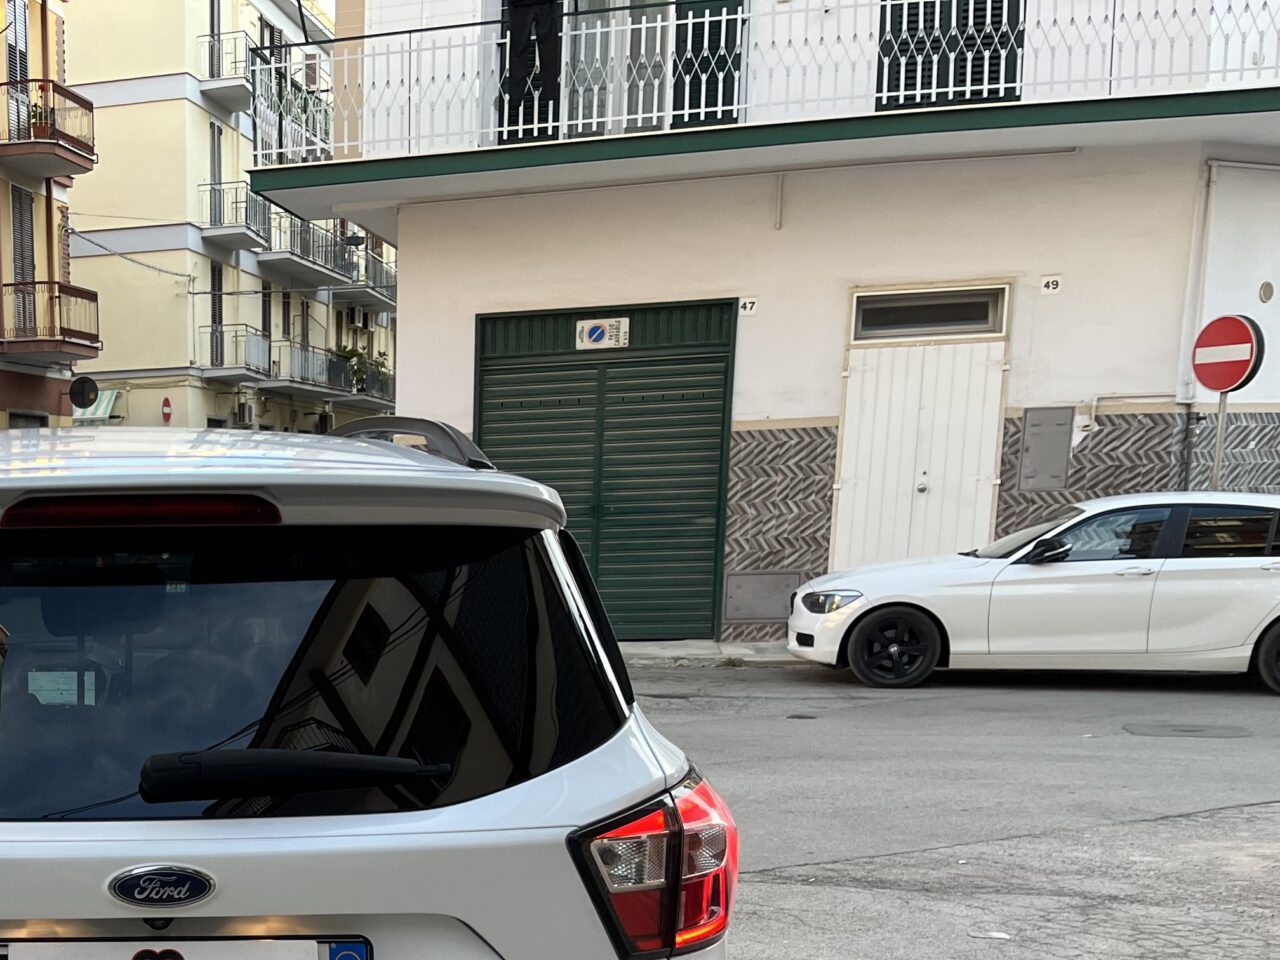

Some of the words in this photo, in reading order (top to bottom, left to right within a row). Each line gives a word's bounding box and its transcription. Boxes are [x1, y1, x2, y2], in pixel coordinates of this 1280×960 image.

[1043, 280, 1059, 290] 49
[740, 301, 756, 311] 47
[134, 875, 192, 899] Ford
